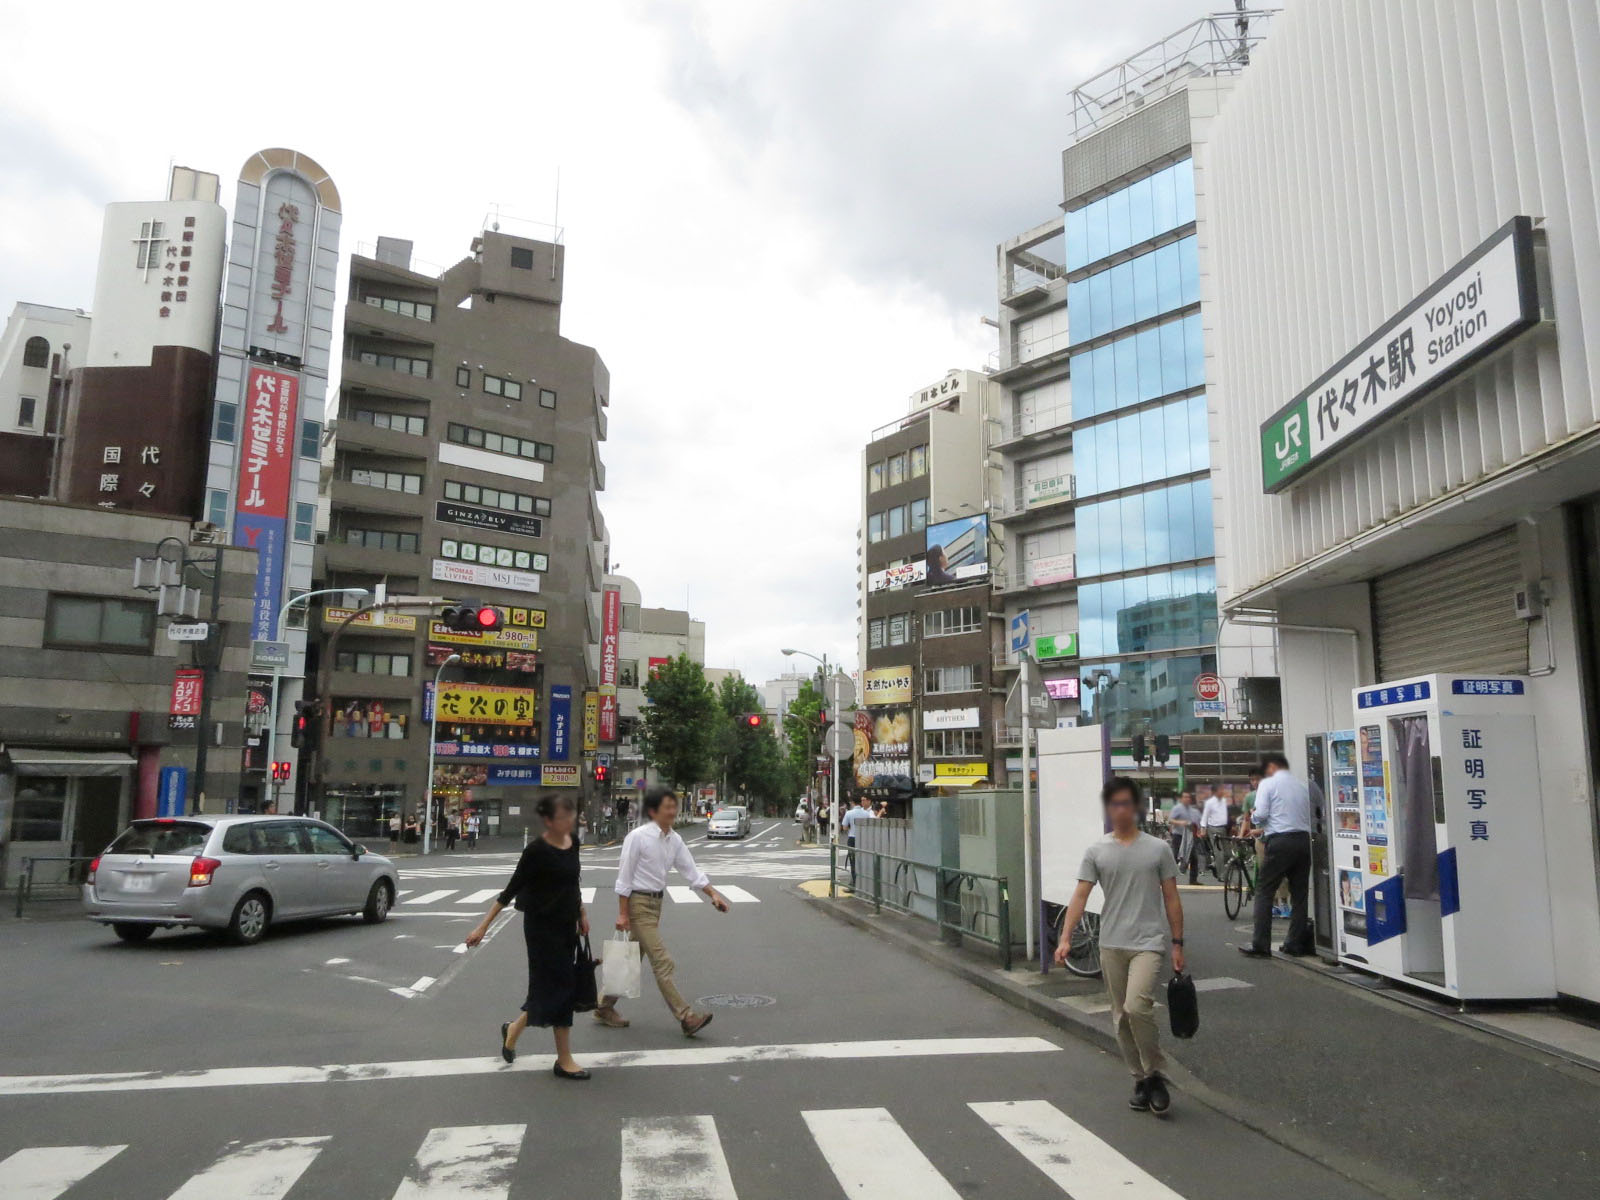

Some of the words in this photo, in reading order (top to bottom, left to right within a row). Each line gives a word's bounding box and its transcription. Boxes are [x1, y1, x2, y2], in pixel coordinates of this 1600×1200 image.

[159, 246, 178, 318] 代々木教会
[1425, 272, 1484, 332] Yoyogi
[1428, 309, 1488, 365] Station
[920, 378, 960, 404] 川本ビル
[1317, 326, 1417, 441] 代々木駅
[245, 374, 276, 508] 代々木ゼミナール
[1275, 413, 1302, 460] JR
[448, 509, 480, 520] GINZA
[444, 565, 474, 576] THOMAS
[444, 572, 474, 583] LIVING
[886, 564, 914, 577] NEWS
[174, 681, 185, 712] スロット
[182, 681, 195, 712] パチンコ
[866, 677, 912, 692] 天然たいやき
[1364, 682, 1423, 707] 証明写真
[1462, 681, 1513, 694] 証明写真
[555, 714, 564, 753] みずほ銀行
[497, 769, 533, 779] みずほ銀行
[1462, 729, 1490, 842] 証明写真
